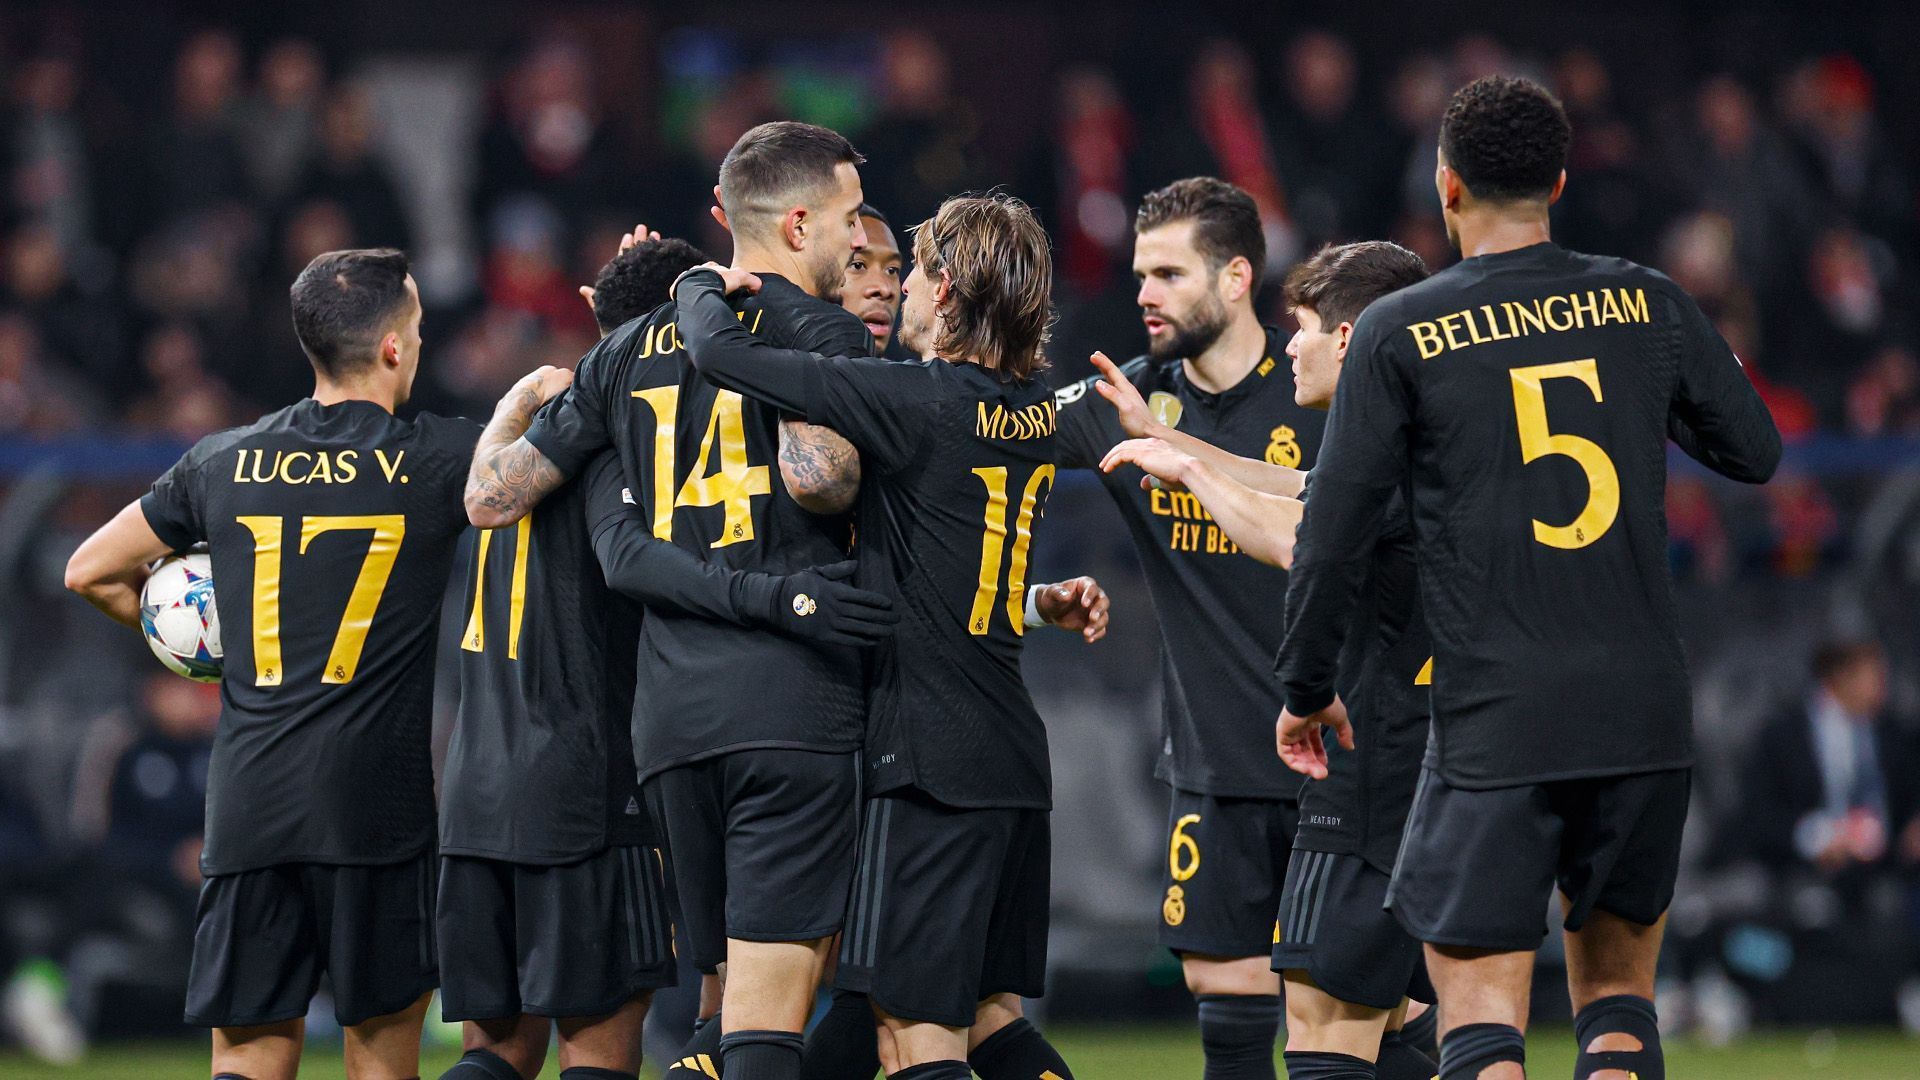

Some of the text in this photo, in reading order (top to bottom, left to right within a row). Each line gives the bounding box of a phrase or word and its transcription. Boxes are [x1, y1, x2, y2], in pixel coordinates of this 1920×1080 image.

[1407, 287, 1650, 360] BELLINGHAM
[976, 399, 1057, 440] MODRI
[1509, 358, 1620, 549] 5
[233, 449, 409, 485] LUCAS V.
[630, 384, 772, 549] 14
[1170, 521, 1201, 552] FLY
[235, 514, 406, 686] 17
[1169, 813, 1202, 882] 6
